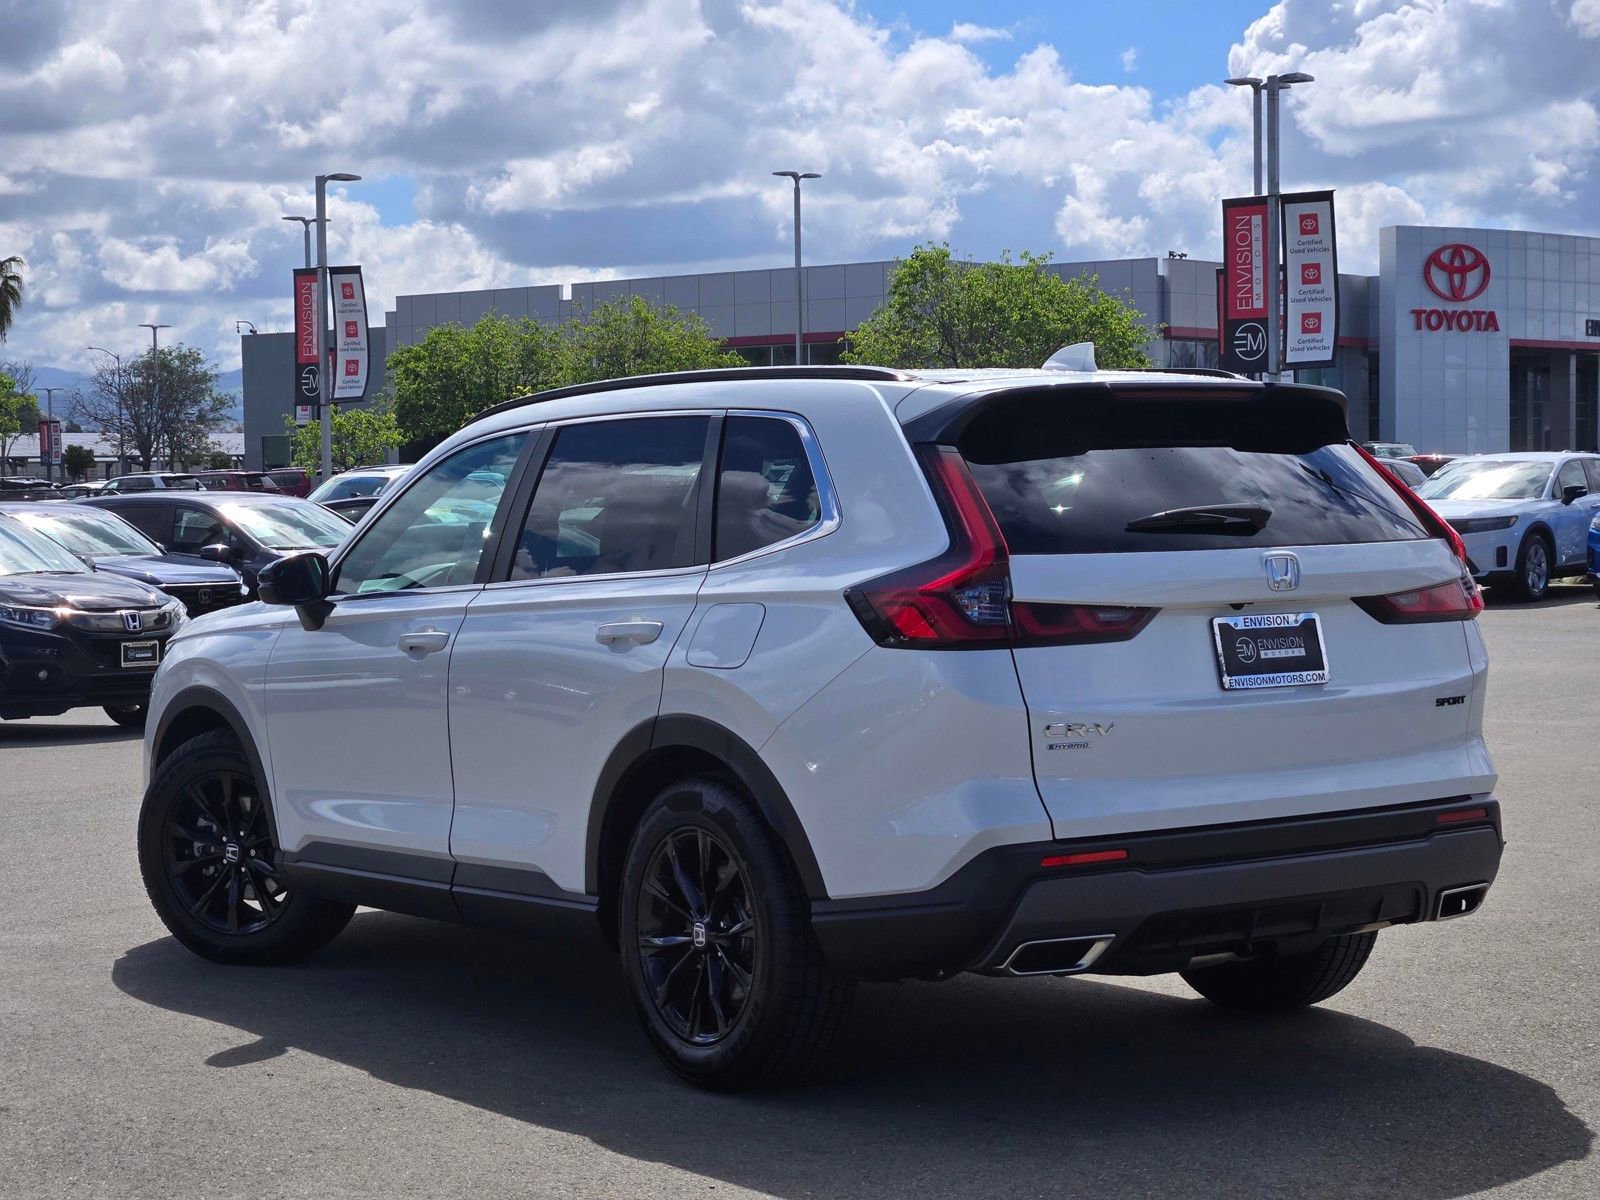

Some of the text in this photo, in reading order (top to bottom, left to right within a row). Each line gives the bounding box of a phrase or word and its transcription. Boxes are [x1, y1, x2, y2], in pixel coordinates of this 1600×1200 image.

[1236, 215, 1252, 310] ENVISION
[1254, 222, 1262, 301] MOTORS
[1298, 288, 1325, 296] Certified
[1307, 295, 1332, 303] Vehicles
[302, 282, 312, 356] ENVISION
[1411, 309, 1500, 332] TOYOTA
[1297, 337, 1324, 345] Certified
[1243, 615, 1290, 628] ENVISION
[1257, 636, 1305, 650] ENVISION
[1263, 649, 1303, 657] MOTORS
[1229, 672, 1326, 688] ENVISIONMOTORS.COM
[1435, 695, 1466, 707] SPORT
[1044, 722, 1116, 738] CR-V
